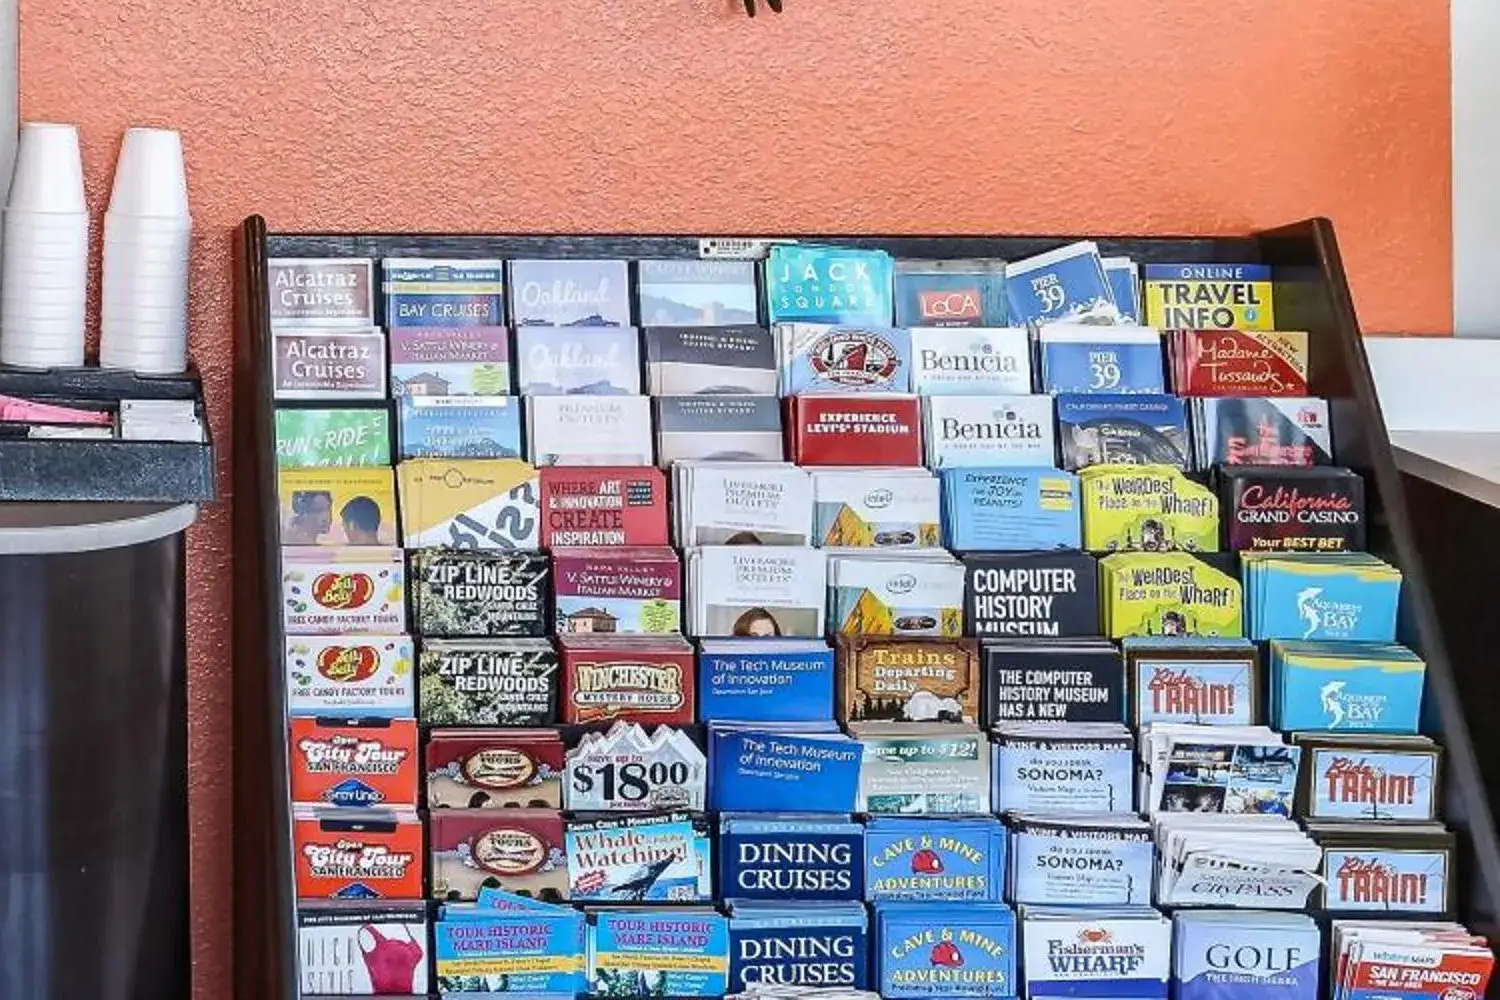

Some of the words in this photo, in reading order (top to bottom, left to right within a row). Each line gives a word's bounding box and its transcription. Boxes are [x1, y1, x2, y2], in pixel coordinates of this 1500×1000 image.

[276, 270, 357, 287] Alcatraz
[781, 263, 870, 282] JACK
[1181, 268, 1243, 279] ONLINE
[1030, 274, 1059, 290] PIER
[281, 290, 353, 306] Cruises
[522, 278, 610, 306] Oakland
[1035, 286, 1065, 312] 39
[1160, 284, 1260, 305] TRAVEL
[400, 304, 426, 317] BAY
[432, 303, 489, 317] CRUISES
[781, 296, 874, 309] SQUARE
[1164, 307, 1235, 329] INFO
[287, 340, 371, 358] Alcatraz
[528, 344, 620, 369] Oakland
[1198, 337, 1273, 360] Madame
[922, 349, 1016, 371] Benicia
[1089, 352, 1118, 362] PIER
[292, 361, 365, 378] Cruises
[1090, 364, 1121, 388] 39
[1200, 360, 1284, 392] Tussauds
[819, 413, 897, 423] EXPERIENCE
[853, 424, 909, 433] STADIUM
[942, 418, 1042, 440] Benicia
[325, 426, 368, 451] RIDE
[550, 481, 598, 495] WHERE
[600, 480, 621, 495] ART
[558, 496, 623, 508] INNOVATION
[1241, 485, 1351, 518] California
[550, 510, 623, 529] CREATE
[1238, 511, 1289, 523] GRAND
[1298, 511, 1359, 523] CASINO
[551, 531, 624, 545] INSPIRATION
[1252, 538, 1282, 547] Your
[1283, 538, 1316, 547] BEST
[1318, 538, 1344, 548] BET
[429, 565, 463, 584] ZIP
[467, 565, 511, 584] LINE
[619, 574, 664, 586] WINERY
[974, 569, 1076, 593] COMPUTER
[444, 586, 537, 600] REDWOODS
[976, 596, 1052, 619] HISTORY
[1324, 612, 1357, 629] BAY
[440, 657, 474, 675] ZIP
[478, 657, 525, 675] LINE
[713, 660, 736, 671] The
[741, 660, 769, 671] Tech
[772, 660, 824, 671] Museum
[873, 650, 955, 666] Trains
[578, 665, 679, 693] WINCHESTER
[712, 674, 726, 684] of
[728, 674, 793, 684] Innovation
[875, 667, 956, 680] Departing
[1000, 671, 1022, 685] THE
[1025, 671, 1093, 686] COMPUTER
[1149, 668, 1193, 687] Ride
[456, 677, 549, 692] REDWOODS
[875, 680, 917, 693] Daily
[1000, 687, 1050, 701] HISTORY
[1053, 688, 1108, 702] MUSEUM
[1000, 703, 1024, 717] HAS
[1028, 703, 1036, 717] A
[1039, 703, 1067, 717] NEW
[1348, 704, 1382, 720] BAY
[300, 741, 351, 763] City
[353, 743, 406, 762] Tour
[742, 738, 765, 751] The
[770, 743, 798, 755] Tech
[801, 746, 856, 761] Museum
[900, 747, 918, 757] up
[921, 744, 934, 755] to
[1006, 740, 1036, 750] WINE
[1039, 741, 1047, 750] &
[1052, 742, 1100, 750] VISITORS
[308, 762, 331, 772] SAN
[331, 762, 397, 773] FRANCISCO
[740, 754, 752, 765] of
[755, 756, 821, 772] Innovation
[1326, 757, 1369, 775] Ride
[1017, 767, 1104, 781] SONOMA?
[575, 830, 644, 850] Whale
[1026, 827, 1057, 838] WINE
[1060, 829, 1068, 838] &
[1071, 829, 1122, 841] VISITORS
[1126, 832, 1149, 842] MAP
[303, 845, 351, 866] City
[361, 847, 411, 866] Tour
[576, 841, 688, 868] Watching!
[740, 844, 851, 864] DINING
[873, 839, 914, 867] CAVE
[922, 832, 931, 849] &
[939, 837, 983, 864] MINE
[312, 866, 335, 876] SAN
[336, 866, 404, 877] FRANCISCO
[1037, 856, 1123, 871] SONOMA?
[1338, 856, 1384, 872] Ride
[739, 869, 851, 890] CRUISES
[875, 876, 985, 890] ADVENTURES
[448, 928, 483, 937] TOUR
[488, 925, 552, 936] HISTORIC
[608, 920, 644, 930] TOUR
[650, 920, 712, 932] HISTORIC
[453, 940, 493, 950] MARE
[497, 938, 548, 949] ISLAND
[615, 934, 653, 945] MARE
[657, 935, 708, 946] ISLAND
[740, 937, 854, 959] DINING
[892, 930, 934, 958] CAVE
[941, 928, 952, 941] &
[960, 930, 1004, 957] MINE
[1048, 940, 1144, 955] Fisherman's
[308, 937, 354, 967] HIGH
[1206, 943, 1300, 970] GOLF
[740, 963, 855, 985] CRUISES
[1048, 956, 1144, 976] WHARF
[892, 970, 1005, 983] ADVENTURES
[1206, 974, 1227, 983] THE
[1370, 966, 1399, 980] SAN
[1401, 968, 1481, 985] FRANCISCO
